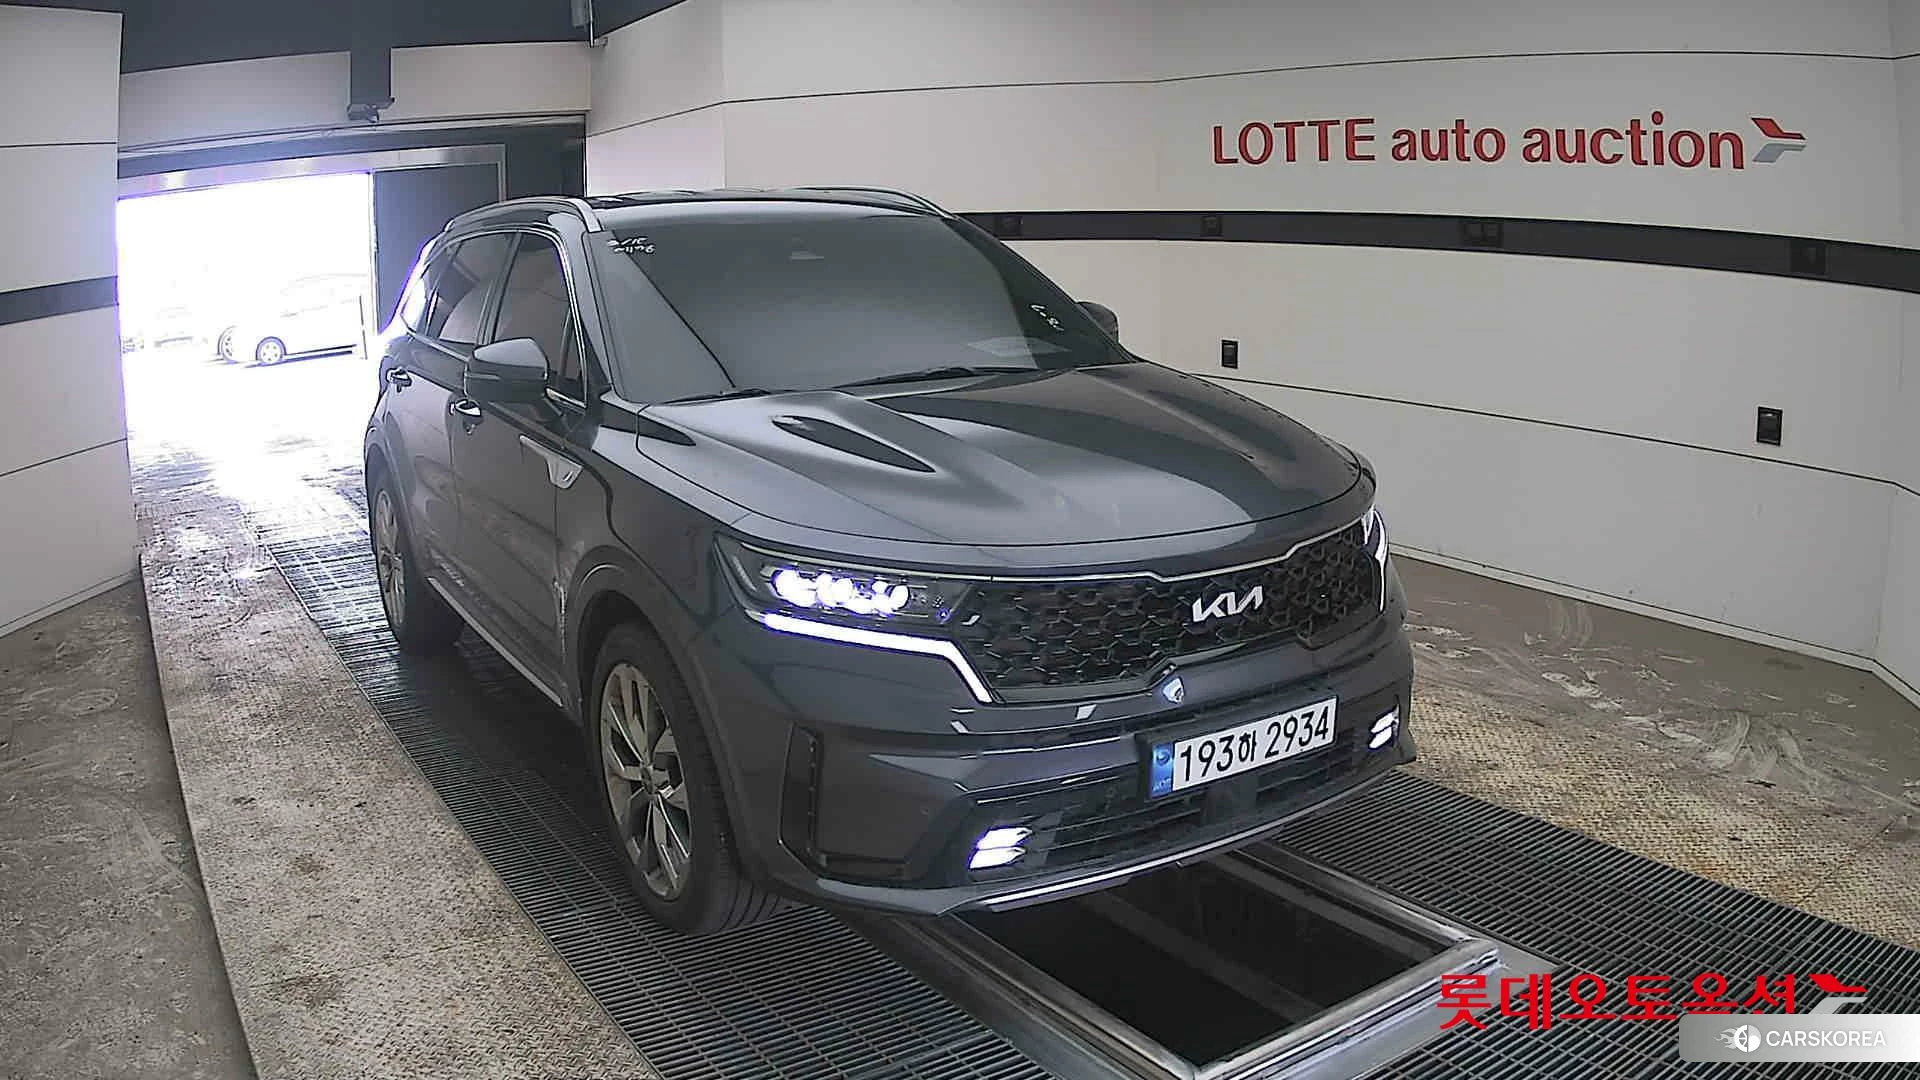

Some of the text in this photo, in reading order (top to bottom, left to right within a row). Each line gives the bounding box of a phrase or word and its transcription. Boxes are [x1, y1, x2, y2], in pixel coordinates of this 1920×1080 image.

[1212, 110, 1746, 170] LOTTE auto auction
[1180, 705, 1329, 783] 193하 2934
